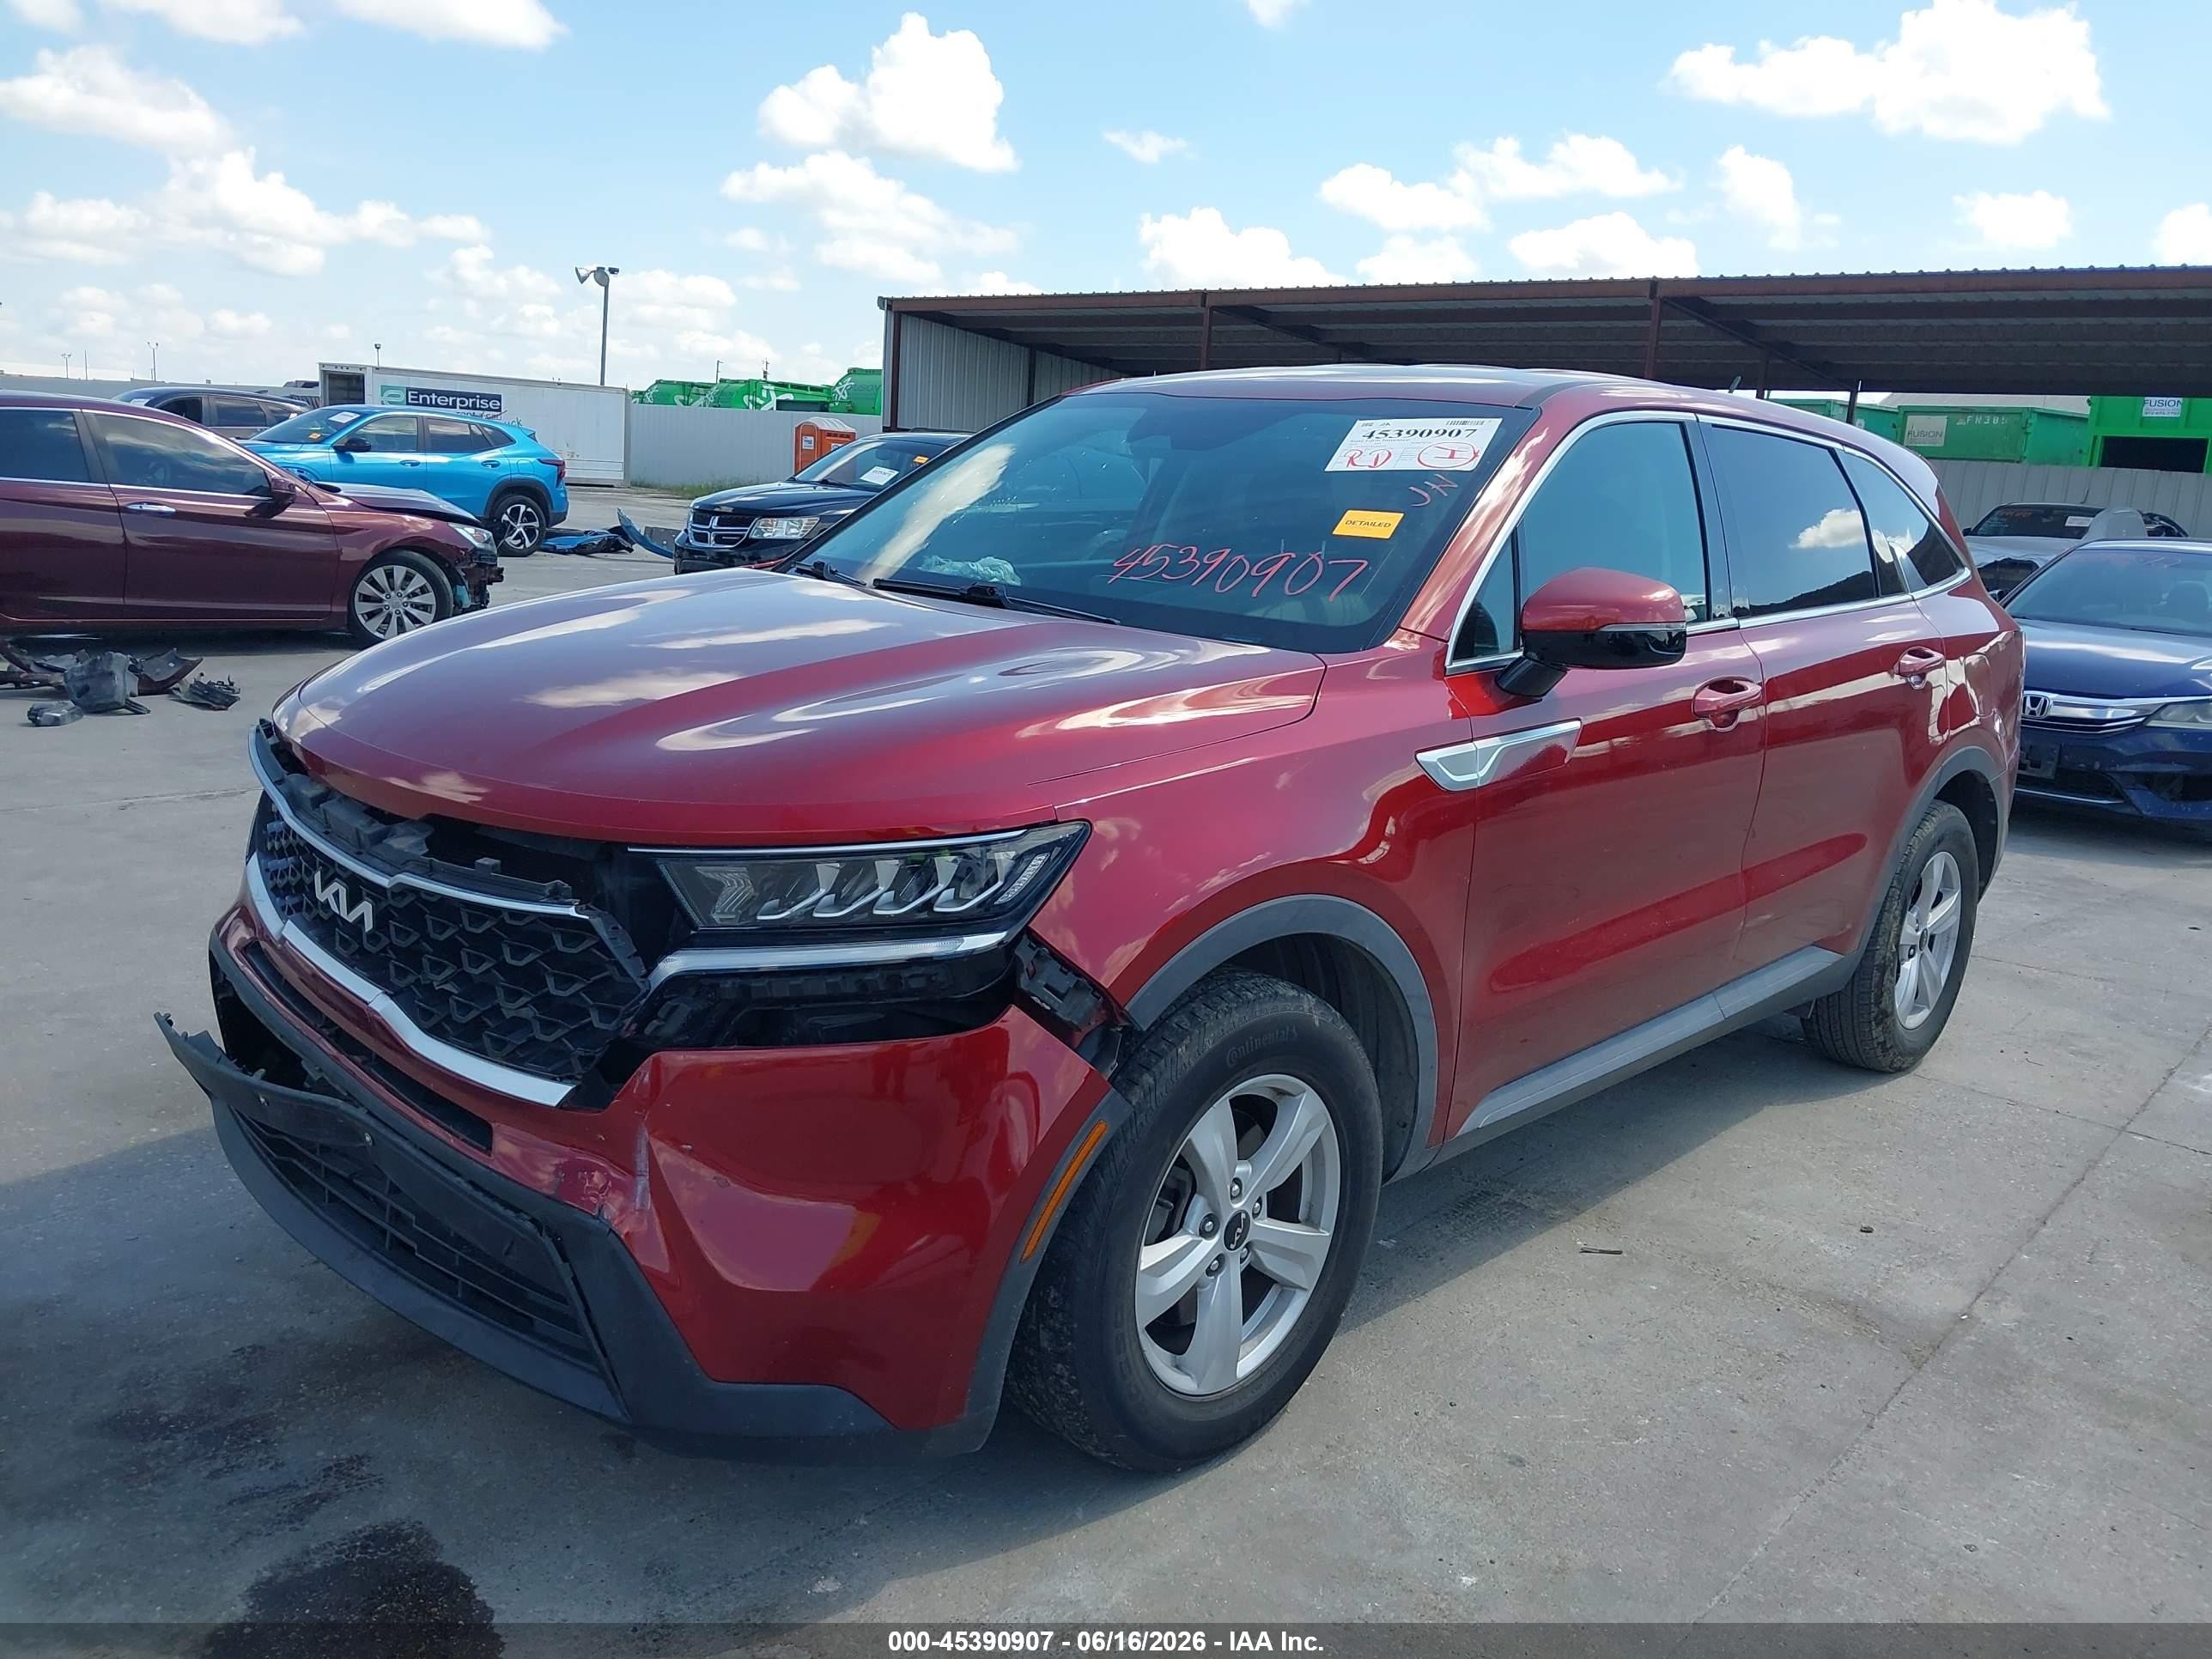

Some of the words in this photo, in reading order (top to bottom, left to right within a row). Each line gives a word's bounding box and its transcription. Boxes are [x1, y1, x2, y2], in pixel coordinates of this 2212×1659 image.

[408, 391, 501, 409] Enterprise
[2143, 399, 2185, 408] FUSION
[1362, 428, 1478, 440] 45390907
[1907, 429, 1943, 439] FUSION
[1345, 520, 1392, 528] DETAILED
[1107, 543, 1370, 602] 45390907
[1227, 1025, 1291, 1067] Continental
